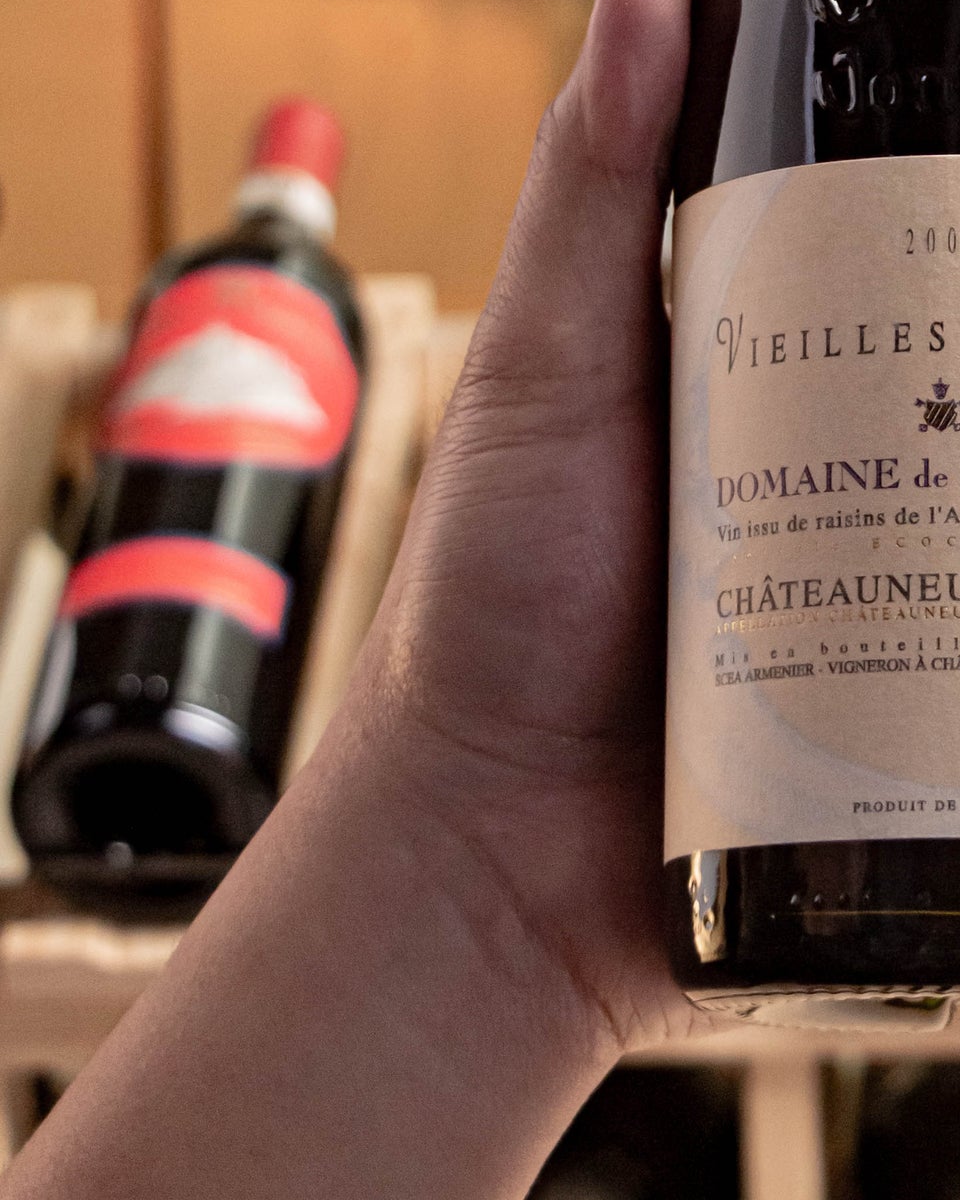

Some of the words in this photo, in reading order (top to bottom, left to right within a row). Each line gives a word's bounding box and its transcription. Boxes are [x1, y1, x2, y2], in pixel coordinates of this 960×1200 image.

[717, 457, 901, 508] DOMAINE
[913, 458, 949, 489] de
[717, 524, 742, 543] Vin
[748, 519, 780, 538] issu
[787, 514, 808, 533] de
[816, 508, 886, 530] raisins
[895, 507, 920, 525] de
[715, 651, 749, 668] Mis
[770, 648, 794, 660] en
[715, 671, 742, 687] SCEA
[745, 663, 815, 683] ARMENIER
[828, 658, 912, 675] VIGNERON
[853, 800, 927, 813] PRODUIT
[934, 800, 957, 812] DE
